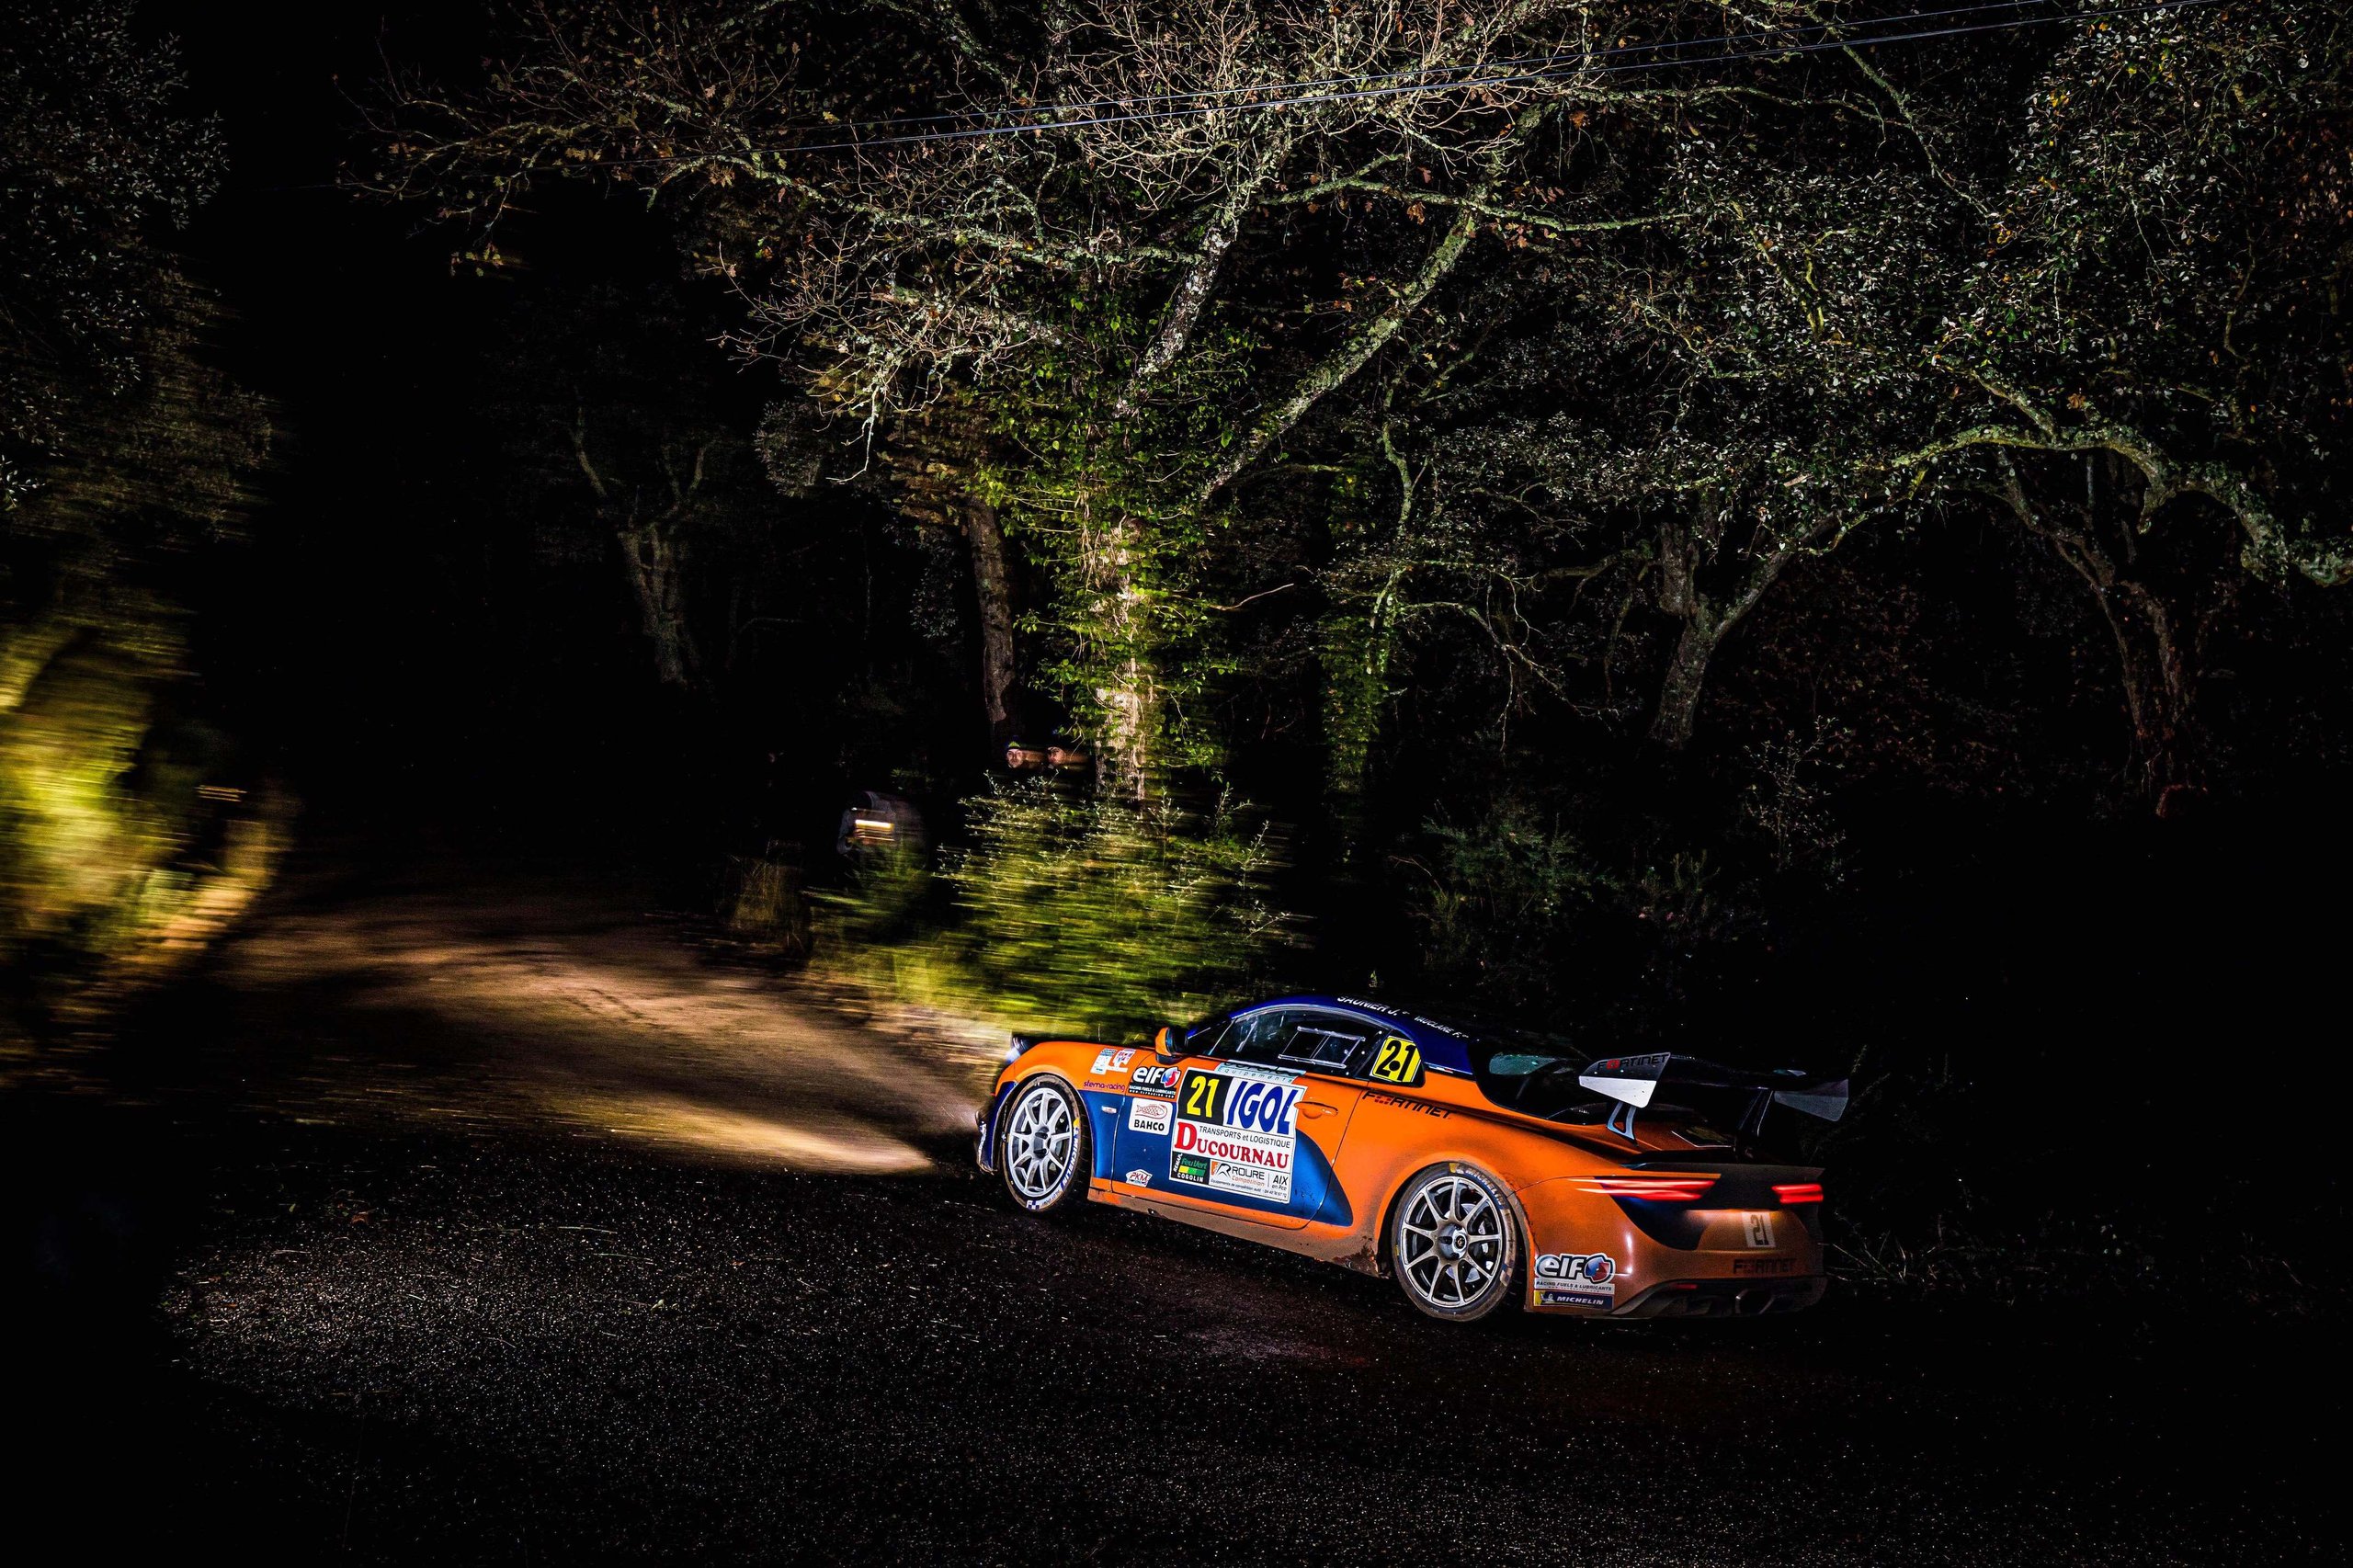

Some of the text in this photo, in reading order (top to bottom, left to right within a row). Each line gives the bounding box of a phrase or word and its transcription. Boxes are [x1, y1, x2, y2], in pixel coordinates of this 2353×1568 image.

[1375, 1040, 1416, 1082] 21
[1132, 1066, 1165, 1085] elf
[1187, 1075, 1298, 1135] 21 IGOL
[1133, 1119, 1165, 1131] BAHCO
[1175, 1121, 1290, 1169] DUCOURNAU
[1199, 1125, 1291, 1149] TRANSPORTS et LOGISTIQUE
[1063, 1133, 1080, 1187] MICHELIN
[1176, 1173, 1204, 1182] COGOLIN
[1232, 1166, 1266, 1180] ROURE
[1272, 1175, 1289, 1186] AIX
[1750, 1214, 1770, 1245] 21
[1539, 1256, 1585, 1278] elf
[1556, 1295, 1604, 1305] MICHELIN
